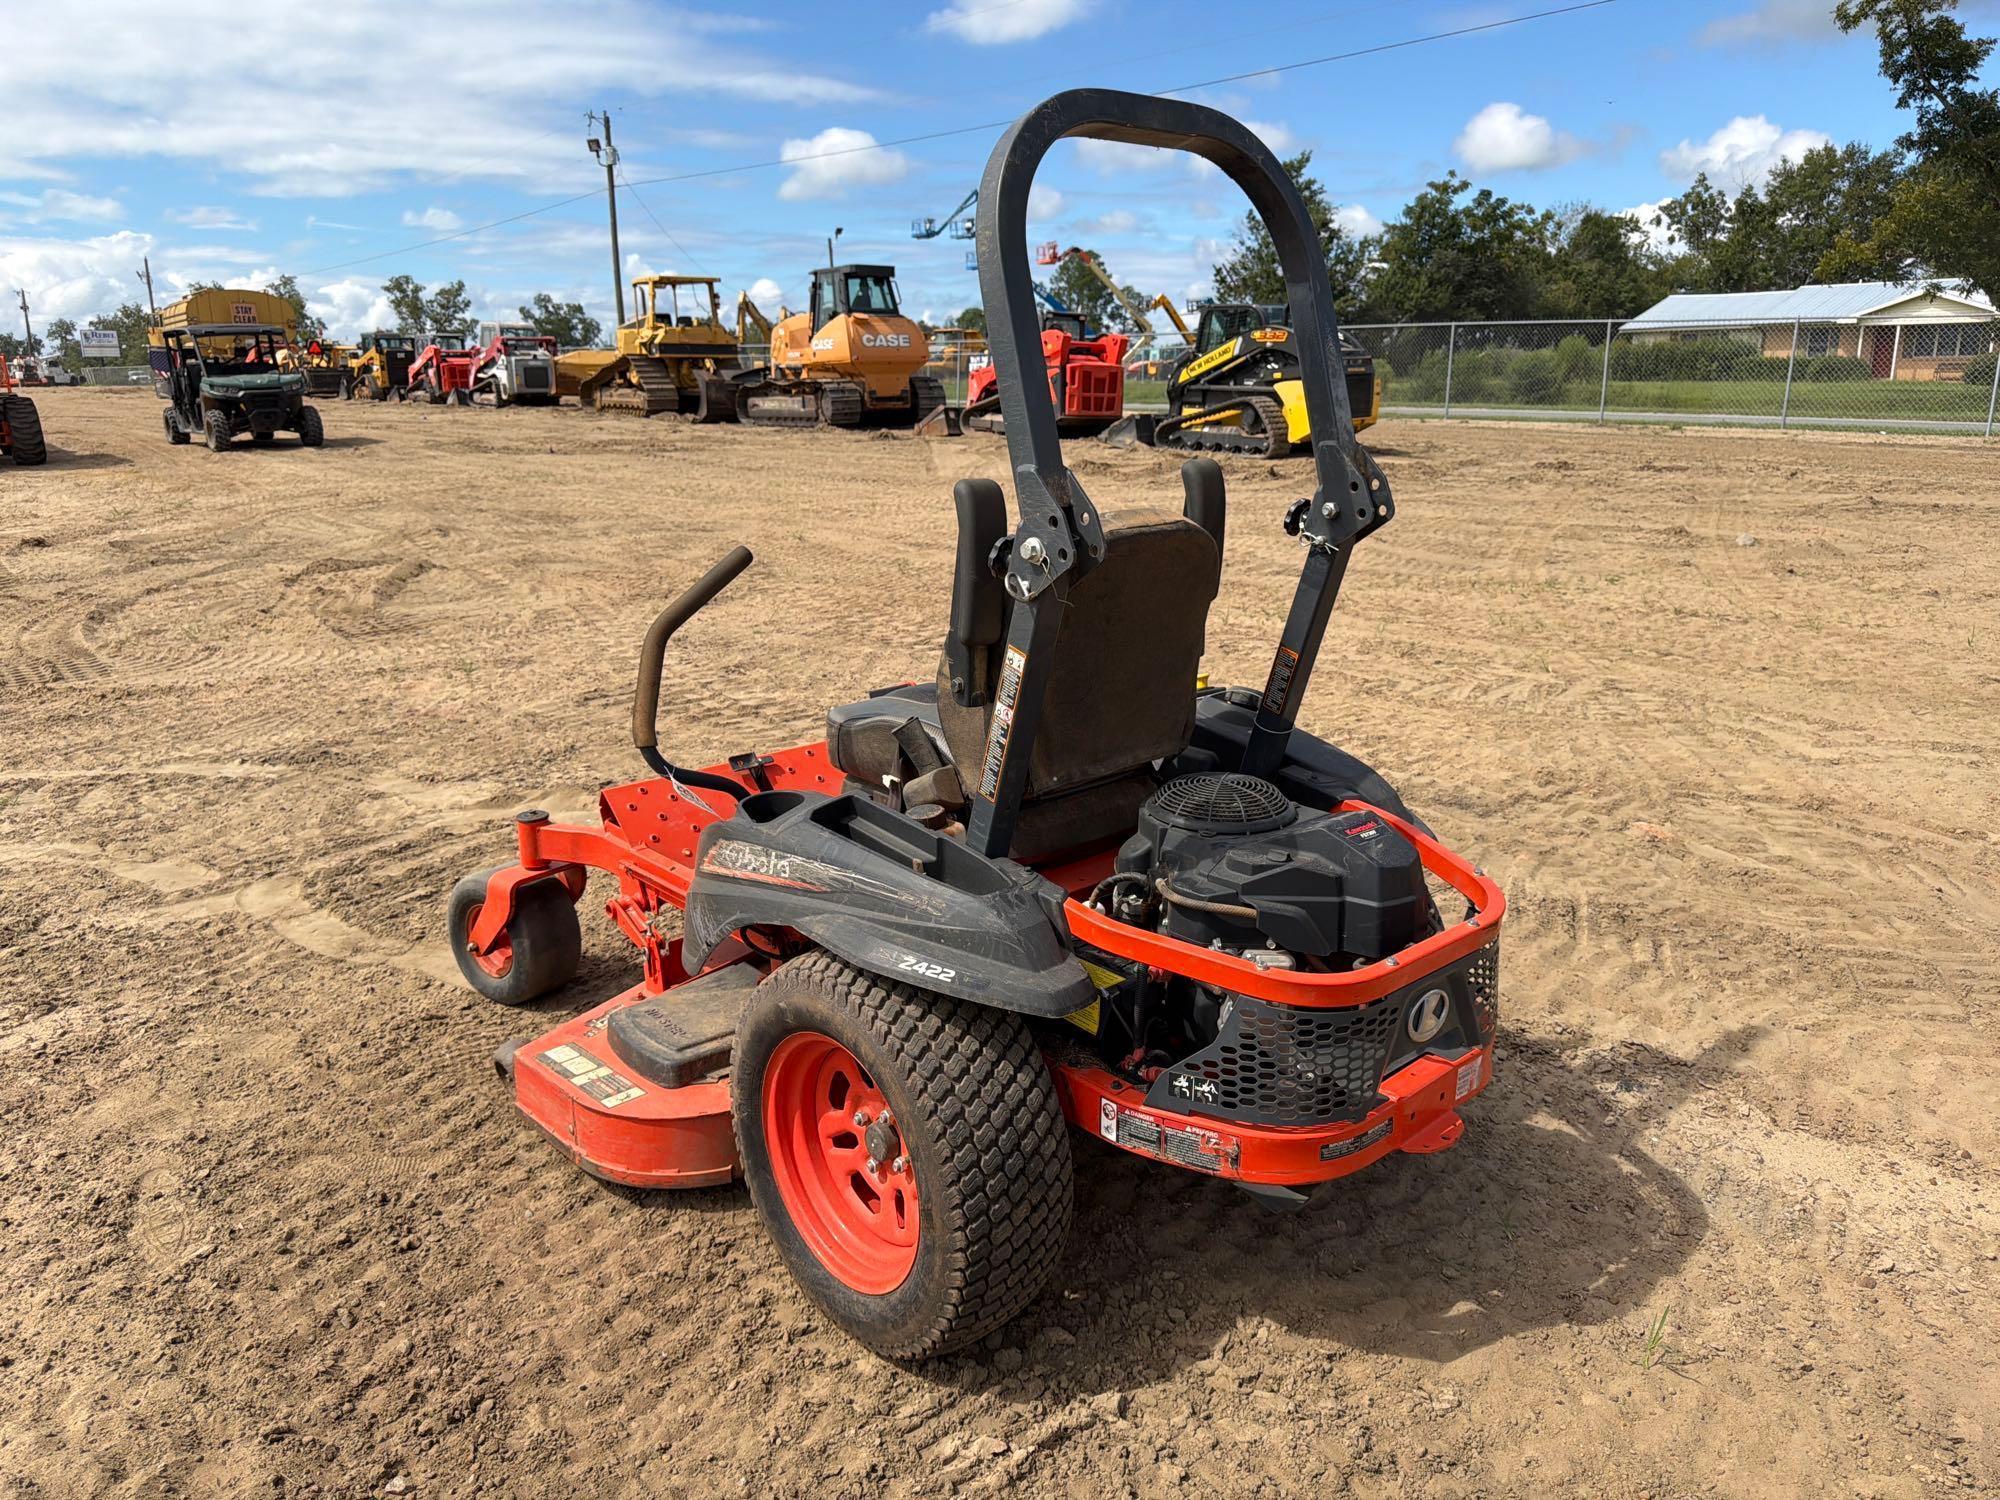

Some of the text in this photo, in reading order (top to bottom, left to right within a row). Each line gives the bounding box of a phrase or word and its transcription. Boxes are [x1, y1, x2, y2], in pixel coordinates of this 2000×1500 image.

[235, 305, 251, 314] STAY
[234, 315, 257, 324] CLEAR
[811, 338, 834, 350] CASE
[862, 334, 910, 347] CASE
[1190, 347, 1231, 372] NEW HOLLAND
[1131, 1110, 1155, 1122] DANGER
